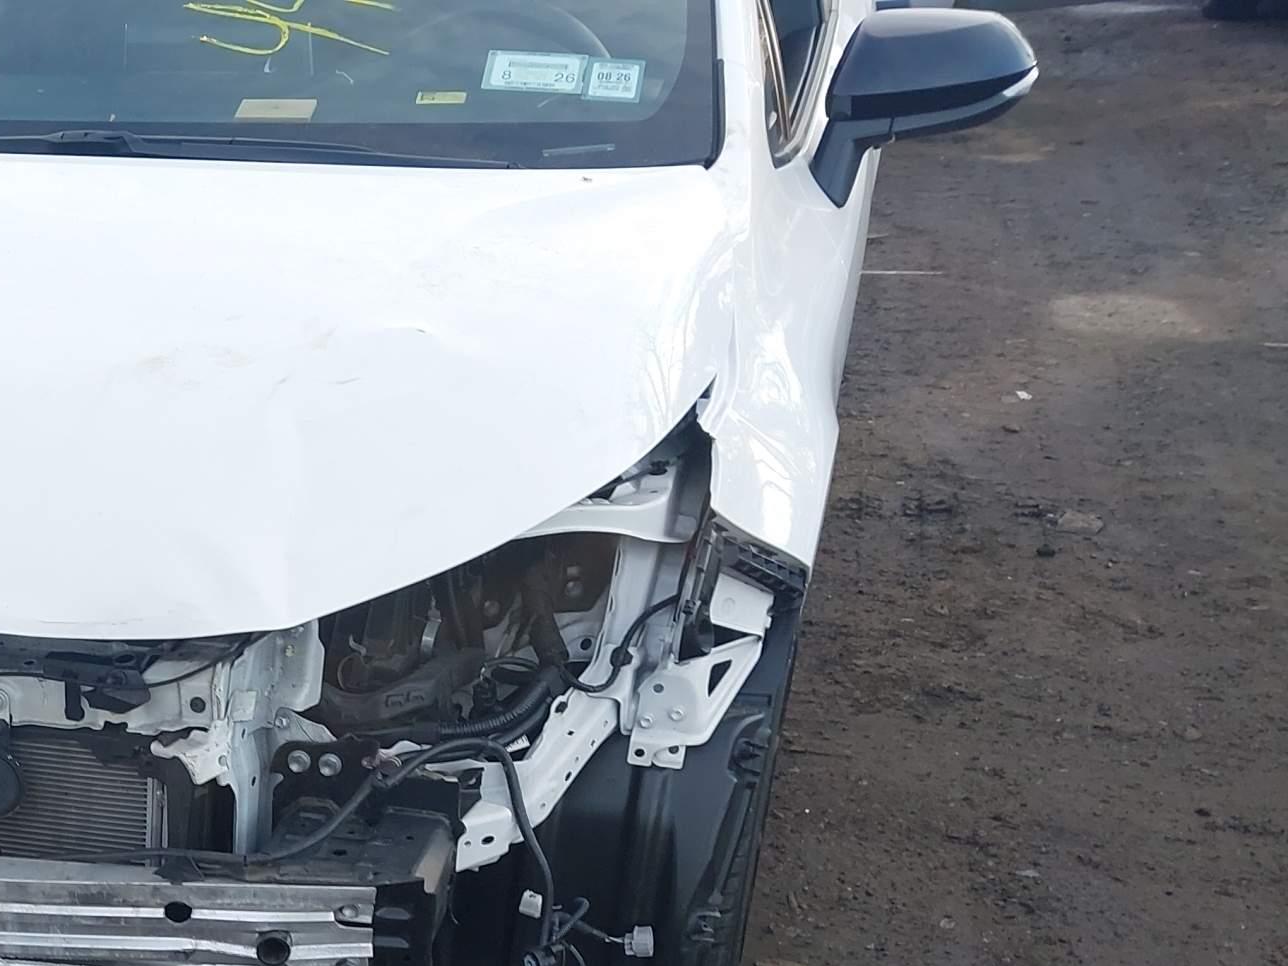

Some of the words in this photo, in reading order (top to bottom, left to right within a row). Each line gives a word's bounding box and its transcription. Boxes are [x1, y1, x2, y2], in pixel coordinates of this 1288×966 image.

[501, 70, 512, 80] 8
[554, 73, 576, 84] 26
[597, 71, 612, 81] 08
[616, 71, 632, 82] 26
